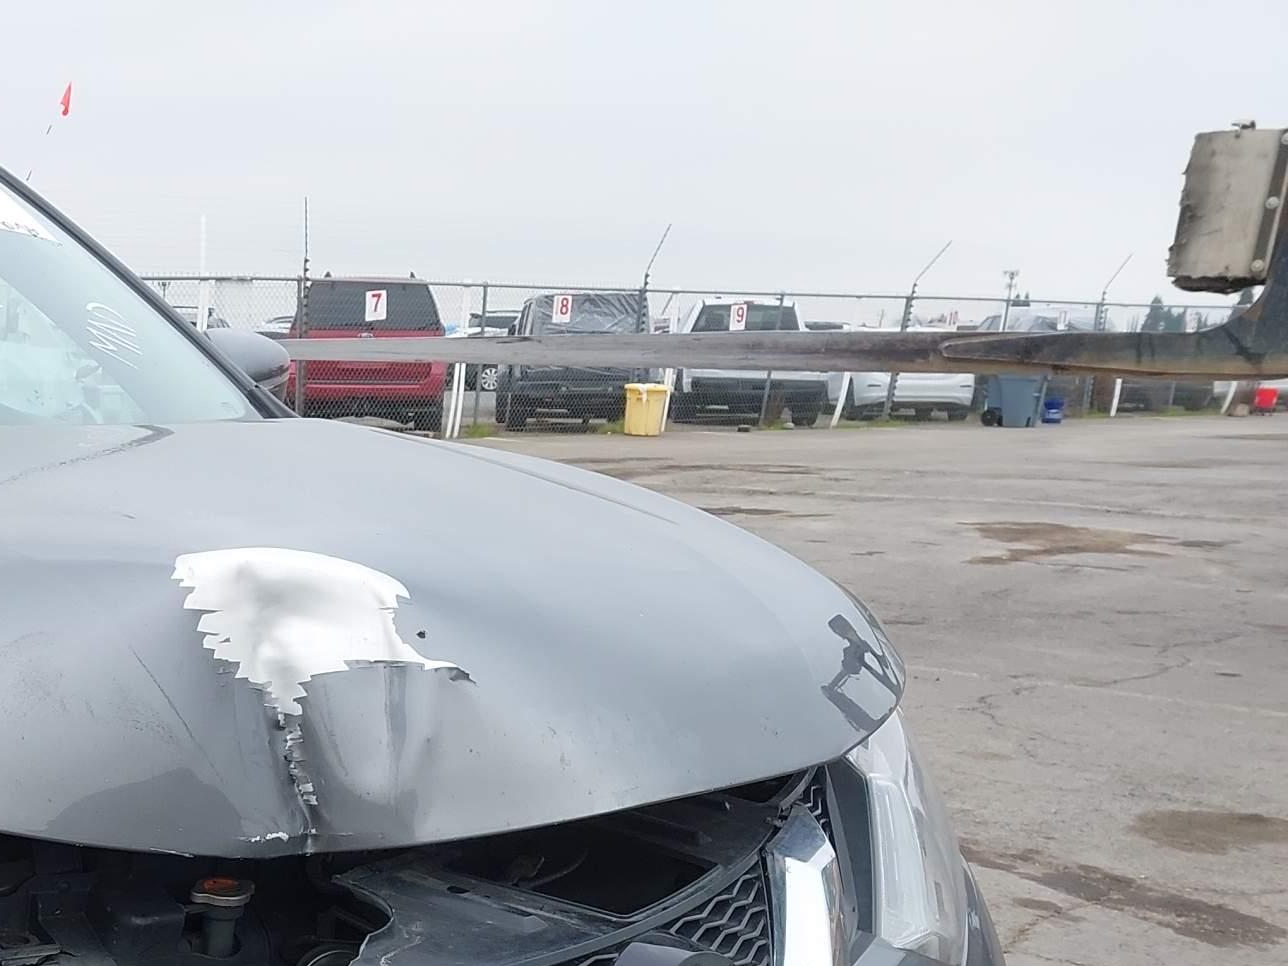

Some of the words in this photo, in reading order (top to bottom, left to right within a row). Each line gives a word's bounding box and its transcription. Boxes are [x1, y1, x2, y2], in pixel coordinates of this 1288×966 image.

[370, 293, 382, 313] 7
[559, 297, 569, 316] 8
[735, 305, 745, 324] 9
